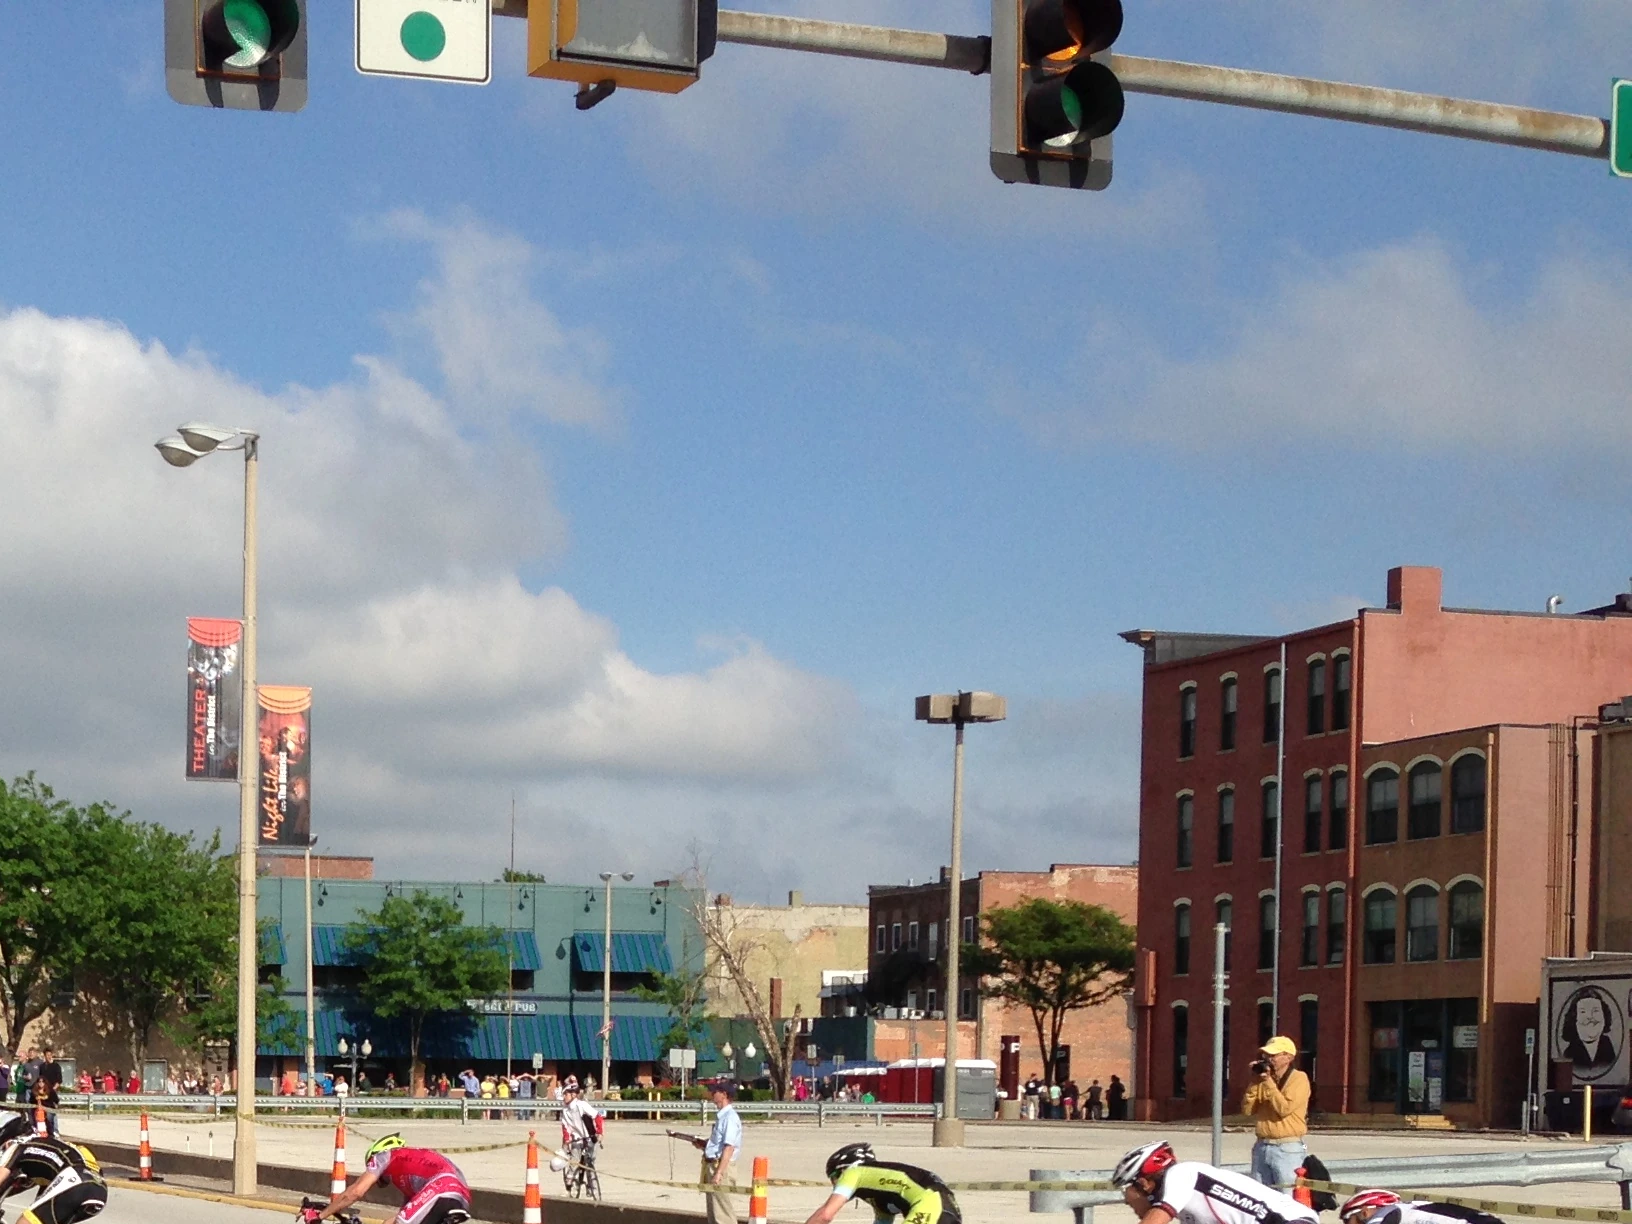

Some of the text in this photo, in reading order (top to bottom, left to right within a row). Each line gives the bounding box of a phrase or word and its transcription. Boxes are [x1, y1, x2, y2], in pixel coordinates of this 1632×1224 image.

[207, 695, 216, 728] District
[192, 689, 207, 773] THEATER
[206, 728, 216, 743] The
[279, 751, 288, 783] District
[278, 784, 287, 799] The
[262, 798, 284, 840] Night
